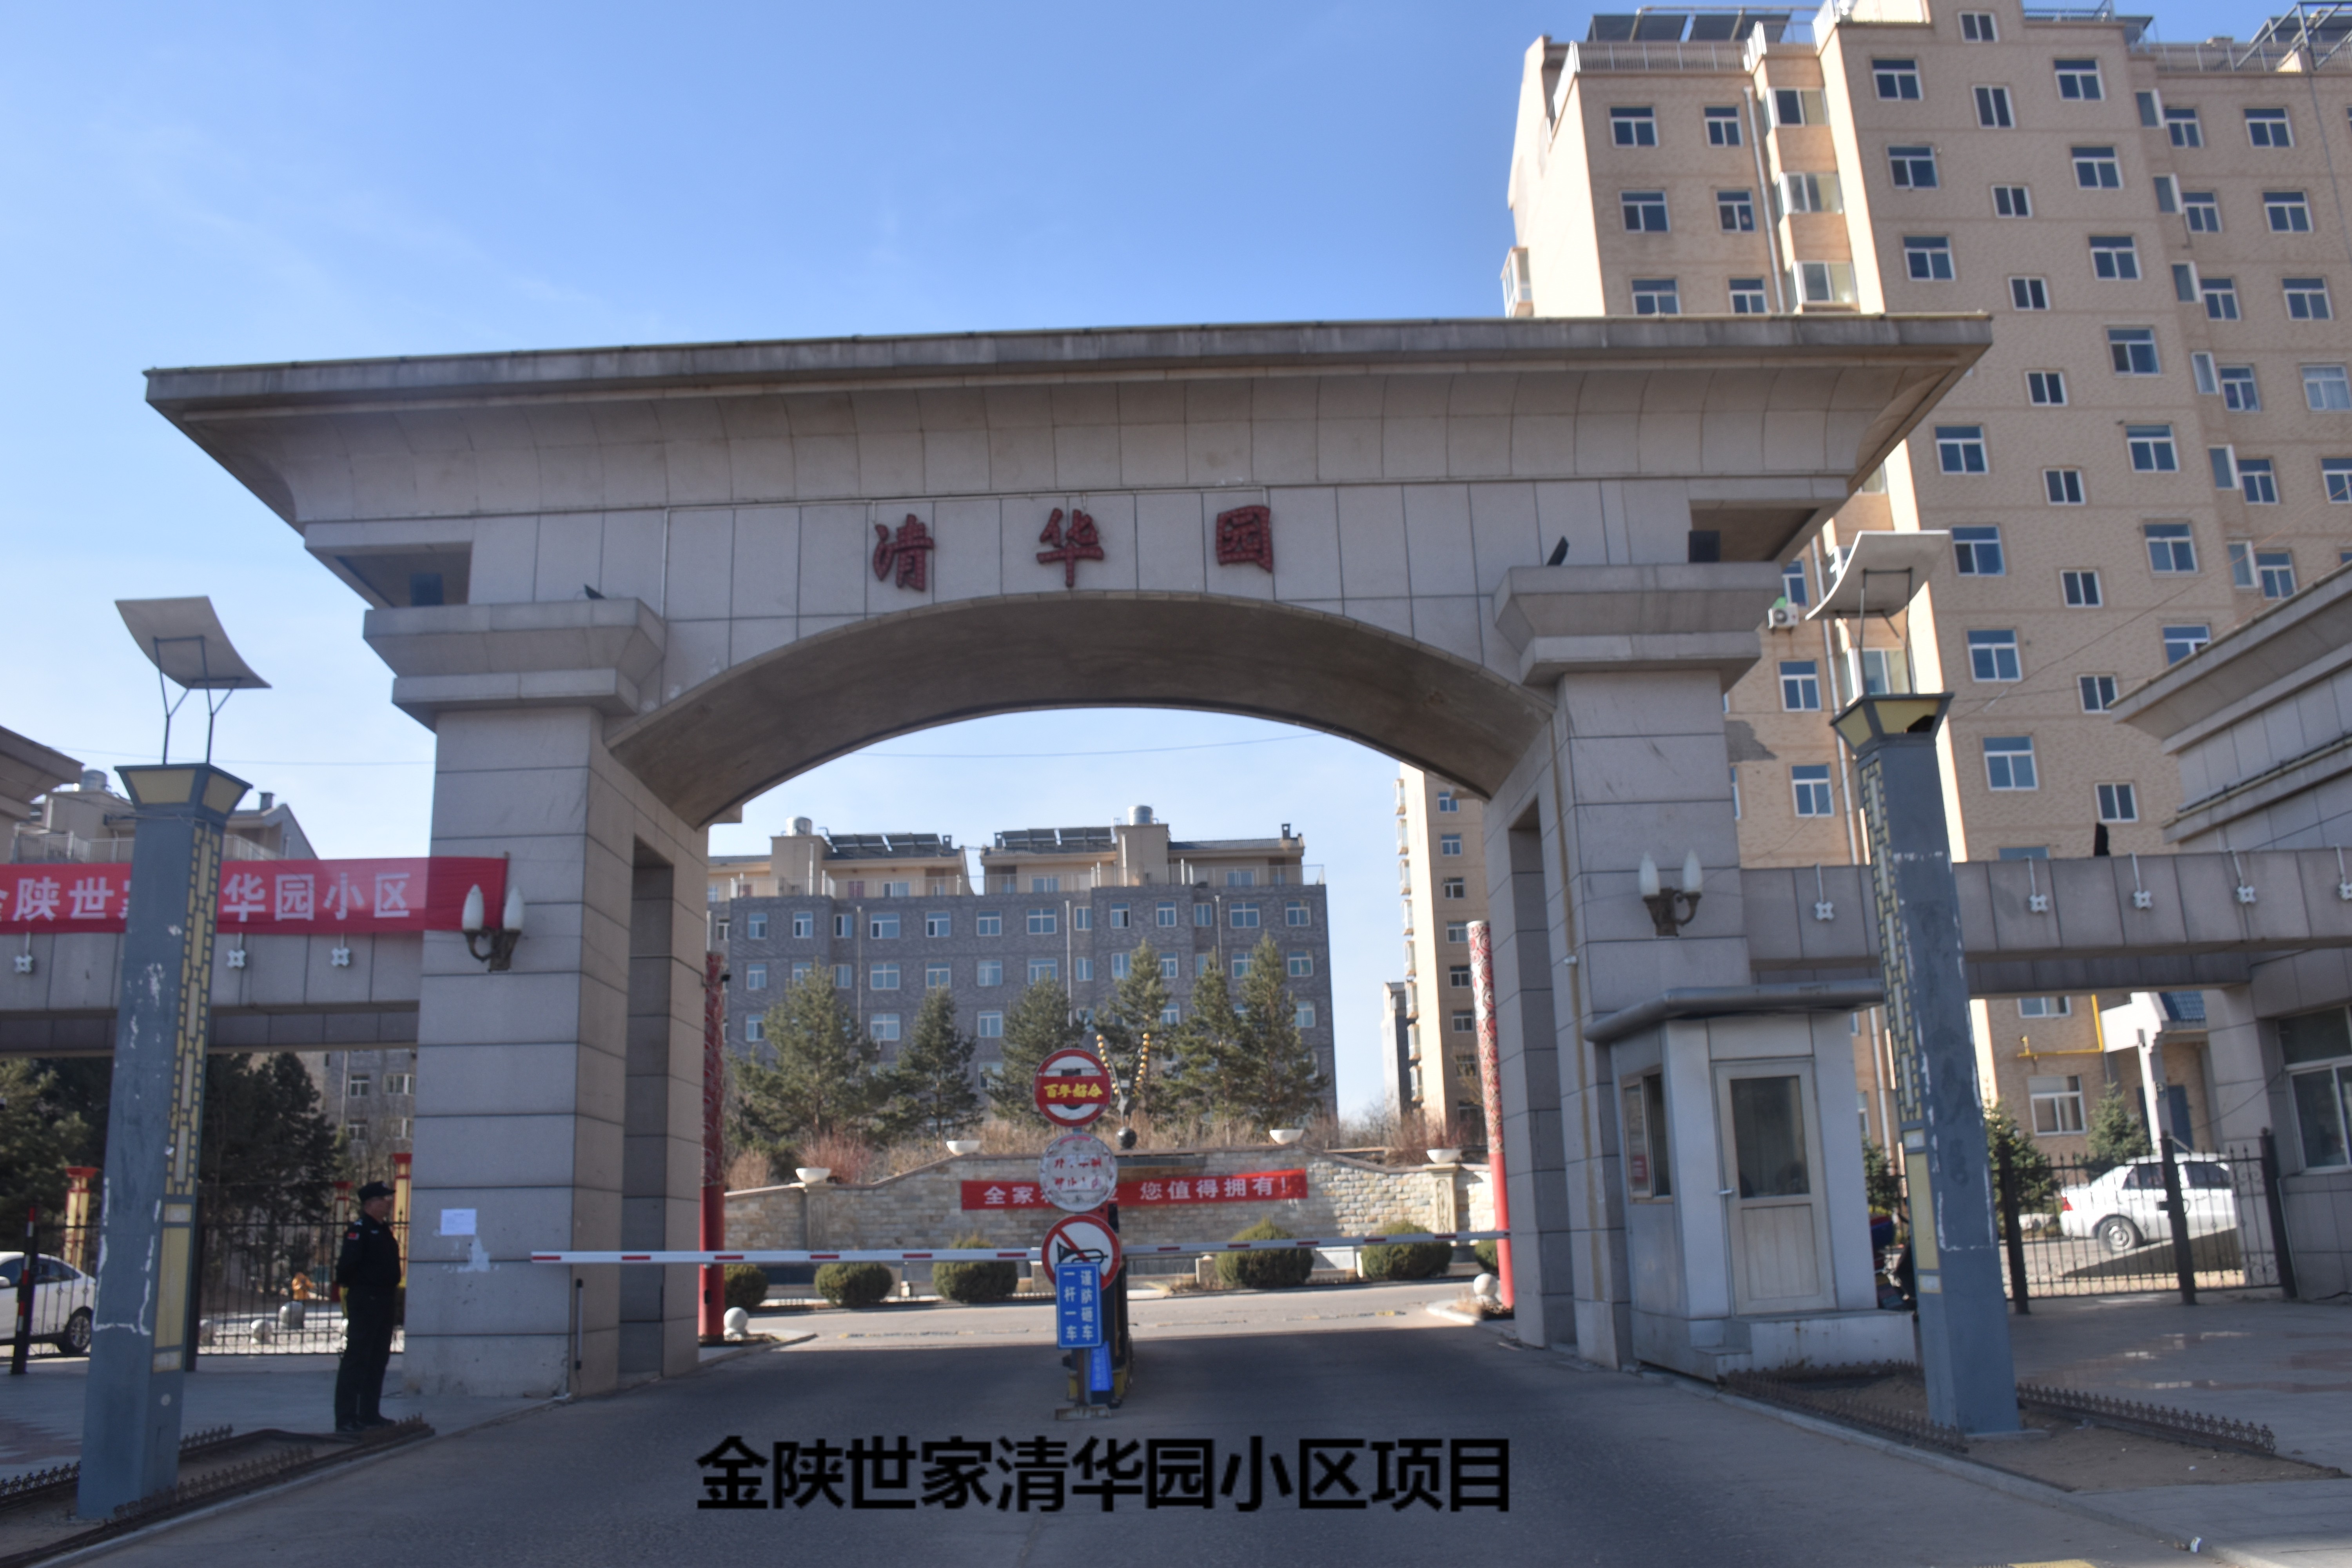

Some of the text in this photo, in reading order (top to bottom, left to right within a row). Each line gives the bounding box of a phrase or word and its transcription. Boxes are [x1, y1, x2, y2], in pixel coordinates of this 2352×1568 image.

[873, 505, 1272, 592] 清华园
[1063, 1271, 1077, 1341] 一杆一车
